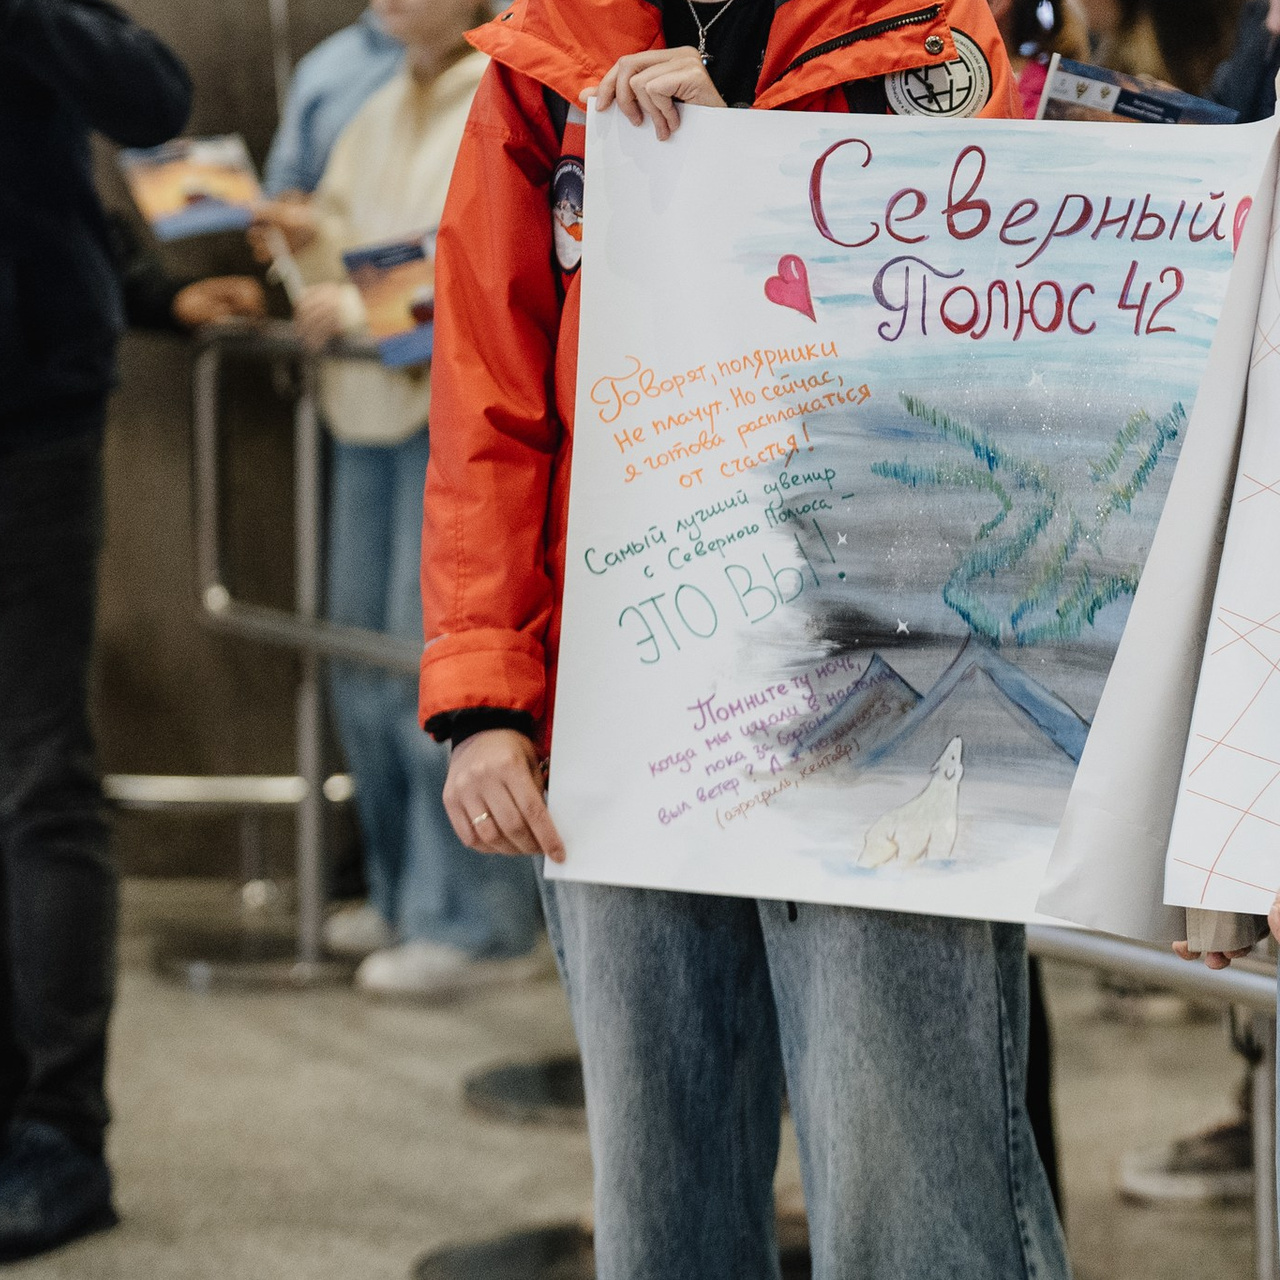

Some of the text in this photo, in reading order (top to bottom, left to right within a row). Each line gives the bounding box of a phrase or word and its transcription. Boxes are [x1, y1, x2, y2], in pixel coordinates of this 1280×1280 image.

[808, 138, 1227, 269] Северный
[872, 255, 1185, 342] Полюс 42
[589, 340, 839, 424] Говорят, полярники
[651, 399, 730, 435] плачут.
[729, 386, 756, 409] Но
[761, 370, 844, 399] сейчас,
[624, 383, 872, 483] я готова расплакаться
[679, 468, 704, 489] от
[584, 467, 837, 576] Самый лучший сувенир
[667, 522, 760, 570] Северного
[764, 496, 834, 529] Полюса
[618, 517, 847, 665] ЭТО ВЫ!
[687, 681, 789, 731] Помните
[817, 657, 862, 678] ночь,
[649, 747, 698, 778] когда
[705, 730, 732, 751] мы
[739, 705, 799, 738] играли
[705, 750, 748, 776] пока
[752, 741, 774, 761] за
[799, 737, 861, 779] кентавр)
[658, 800, 692, 825] выл
